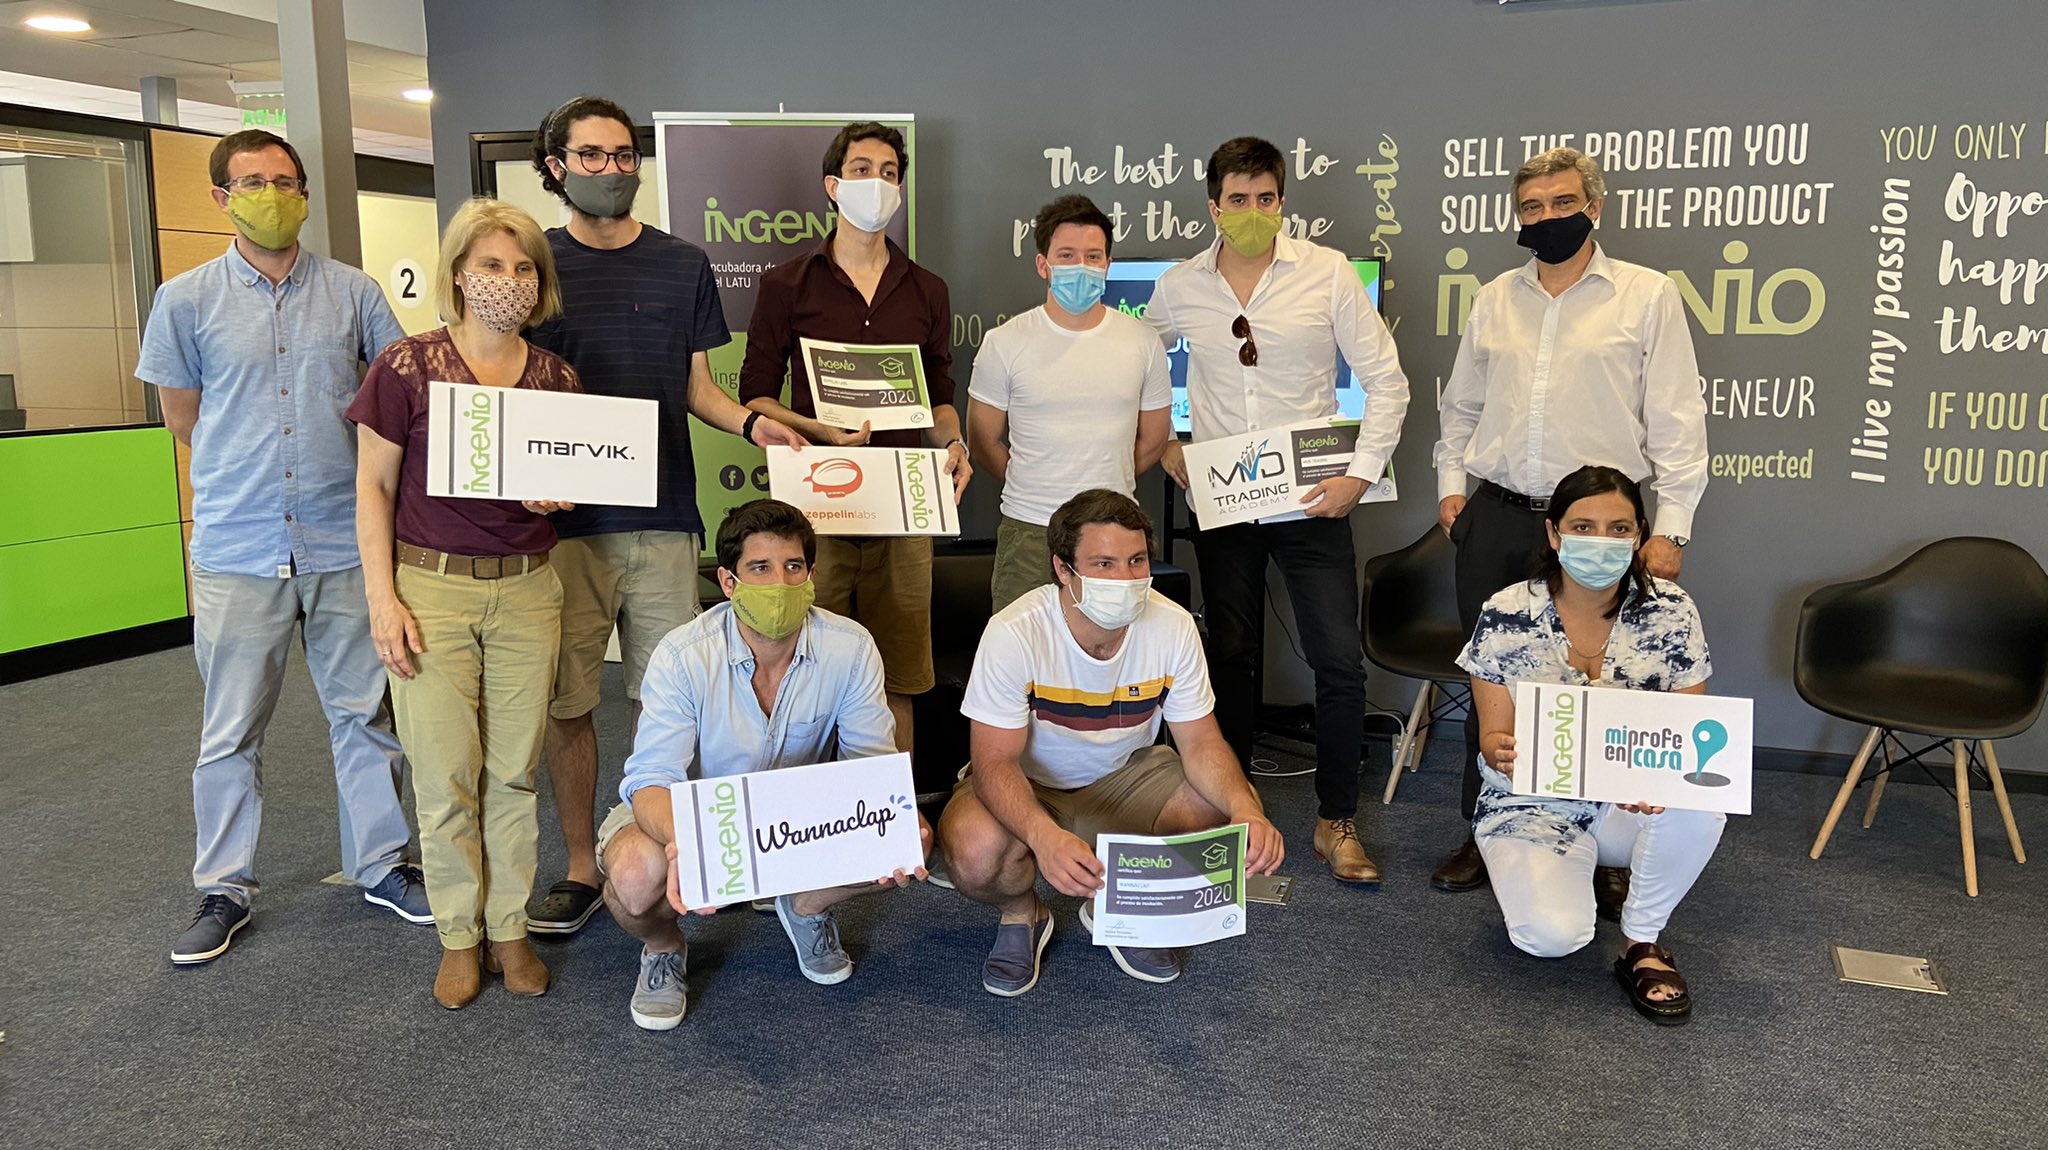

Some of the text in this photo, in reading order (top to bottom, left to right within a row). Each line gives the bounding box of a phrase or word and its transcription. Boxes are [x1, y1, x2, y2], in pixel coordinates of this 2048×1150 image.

[1444, 137, 1510, 179] SELL
[1585, 125, 1732, 173] PROBLEM
[1744, 122, 1809, 165] YOU
[1880, 125, 1937, 163] YOU
[1955, 122, 2027, 162] ONLY
[1043, 146, 1107, 188] The
[1114, 143, 1183, 188] best
[1290, 137, 1340, 181] to
[1355, 133, 1402, 263] create
[1441, 193, 1521, 235] SOLV
[1617, 187, 1673, 229] THE
[1683, 183, 1834, 228] PRODUCT
[1944, 172, 2048, 238] Oppo
[1141, 200, 1206, 242] the
[400, 268, 417, 299] 2
[726, 277, 751, 288] LATU
[1938, 240, 2048, 305] happ
[953, 313, 982, 348] DO
[1850, 178, 1911, 483] I live my passion
[879, 389, 916, 405] 2020
[1927, 391, 1957, 429] IF
[1966, 391, 2028, 431] YOU
[1711, 448, 1814, 484] expected
[1923, 447, 1985, 486] YOU
[1214, 482, 1290, 507] TRADING
[1218, 495, 1289, 515] ACADEMY
[805, 509, 877, 520] zeppelinlabs
[1604, 745, 1626, 762] en
[755, 799, 896, 854] Wannaclap
[1193, 883, 1232, 909] 2020
